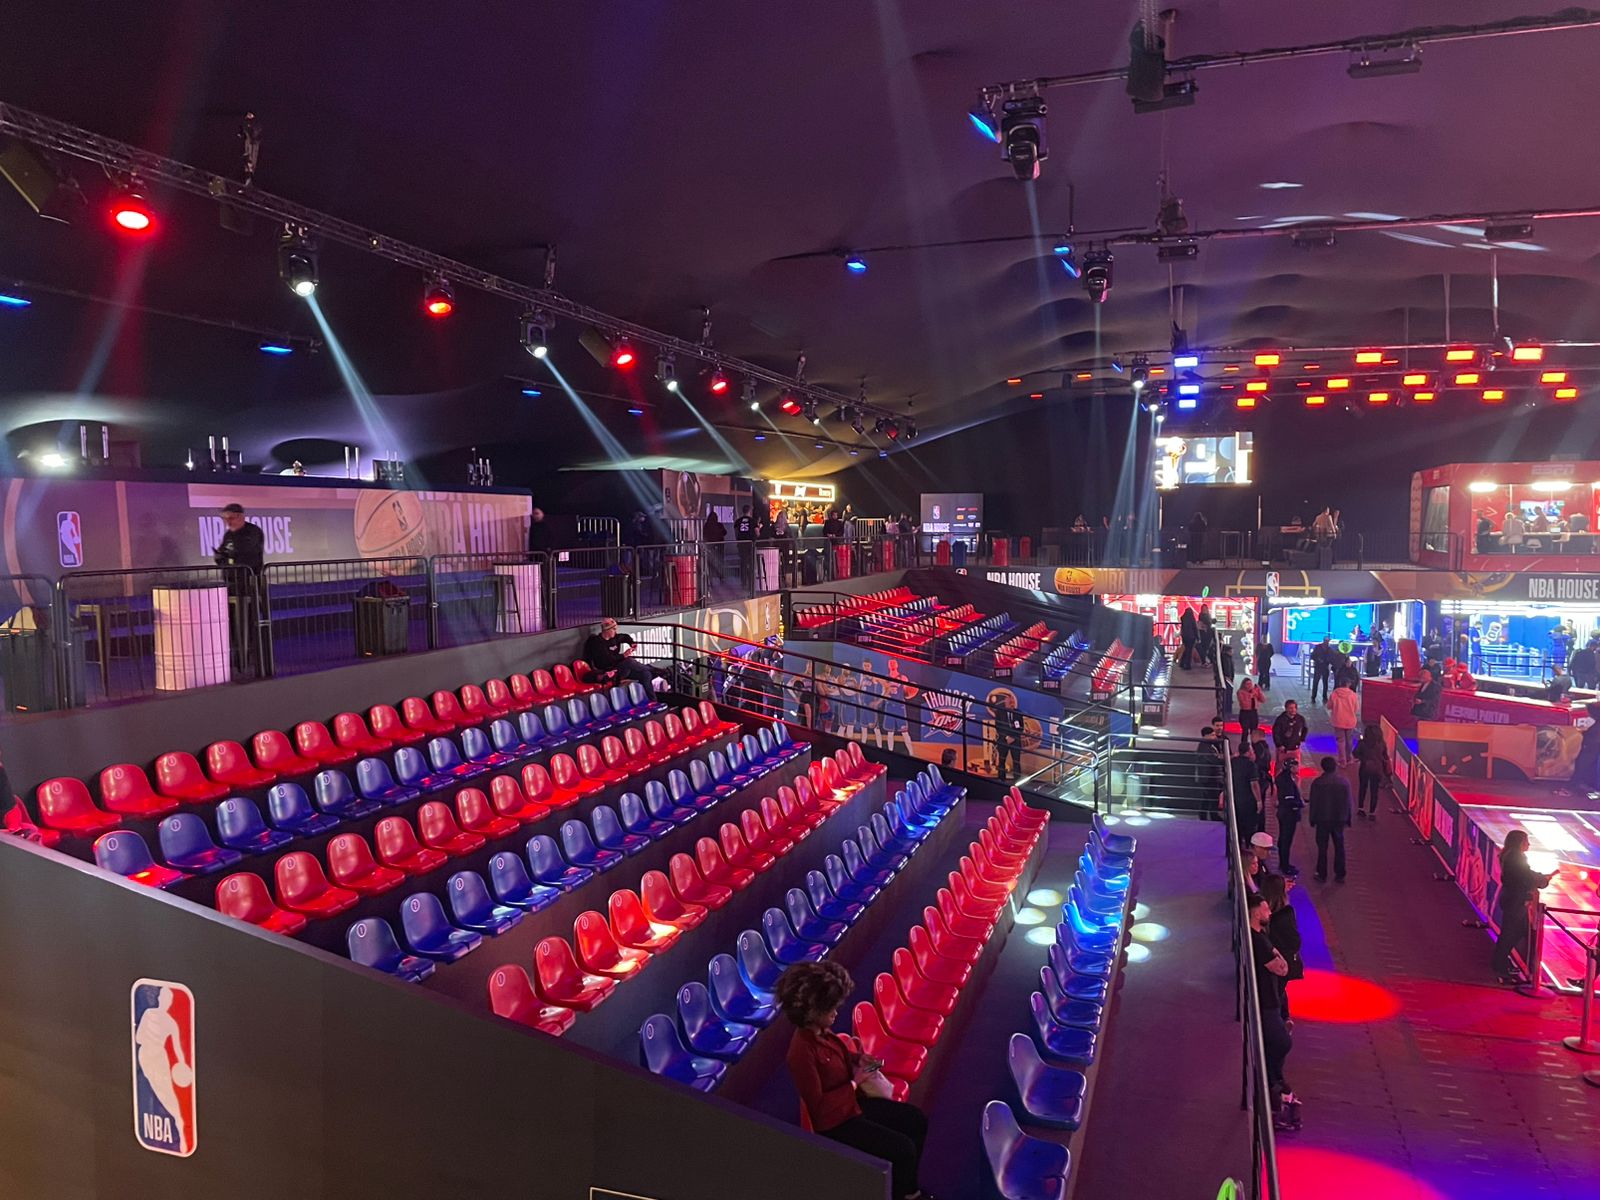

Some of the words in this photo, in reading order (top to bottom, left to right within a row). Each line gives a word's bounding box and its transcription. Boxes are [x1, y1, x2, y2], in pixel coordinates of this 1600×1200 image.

[1528, 578, 1555, 599] NBA
[1557, 578, 1599, 600] HOUSE
[143, 1112, 174, 1144] NBA
